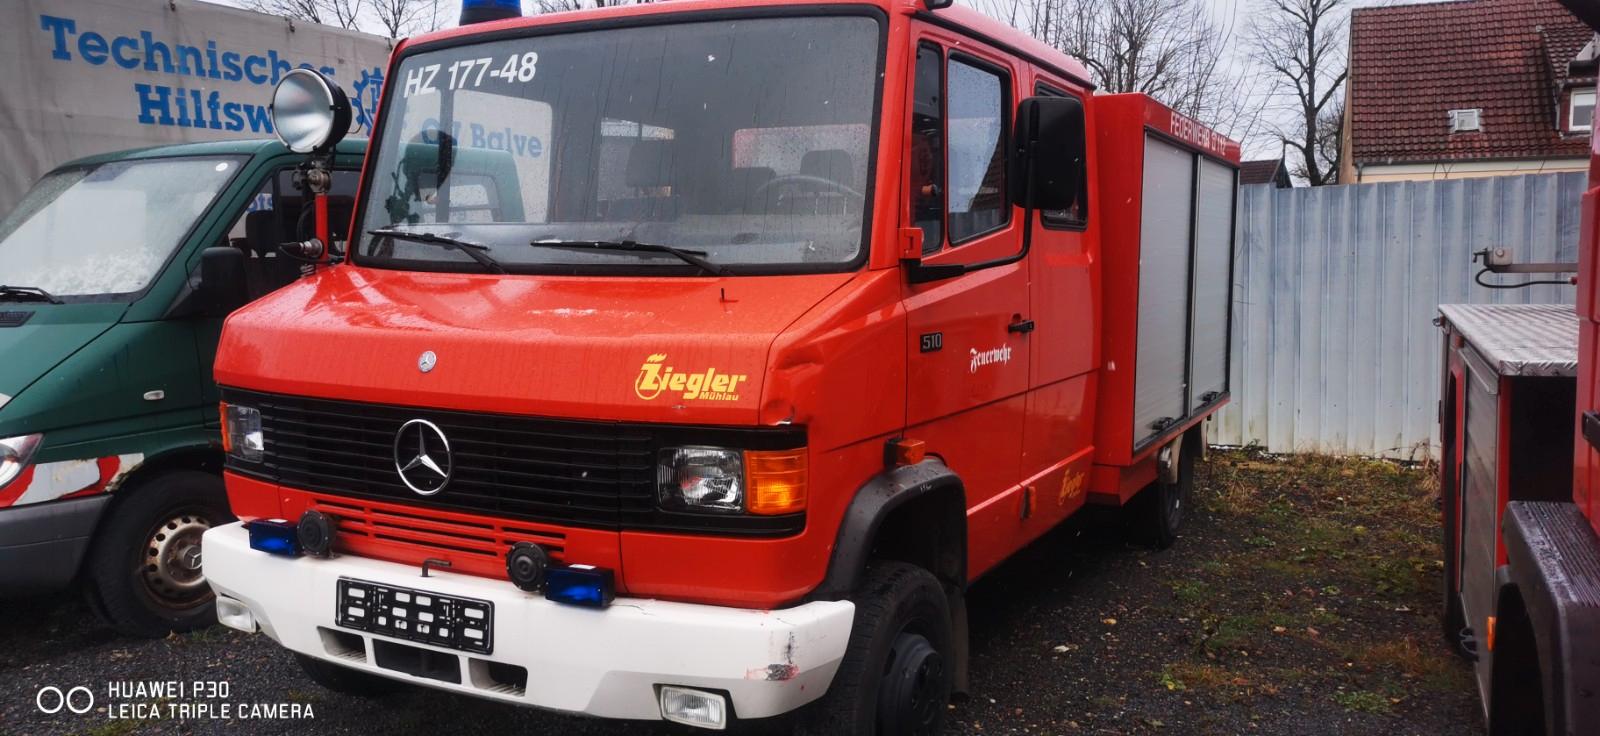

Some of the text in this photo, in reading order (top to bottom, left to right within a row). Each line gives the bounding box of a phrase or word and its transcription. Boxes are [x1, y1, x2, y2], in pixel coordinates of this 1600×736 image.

[40, 15, 335, 86] Technisch
[404, 52, 538, 98] HZ 177-48
[135, 83, 274, 134] Hilfsw
[470, 122, 542, 158] Balve
[1170, 110, 1210, 150] FEUERWEHR
[922, 333, 942, 350] 510
[969, 343, 1012, 374] Feuerwehr
[635, 353, 747, 400] Ziegler
[699, 391, 739, 401] Mühlau
